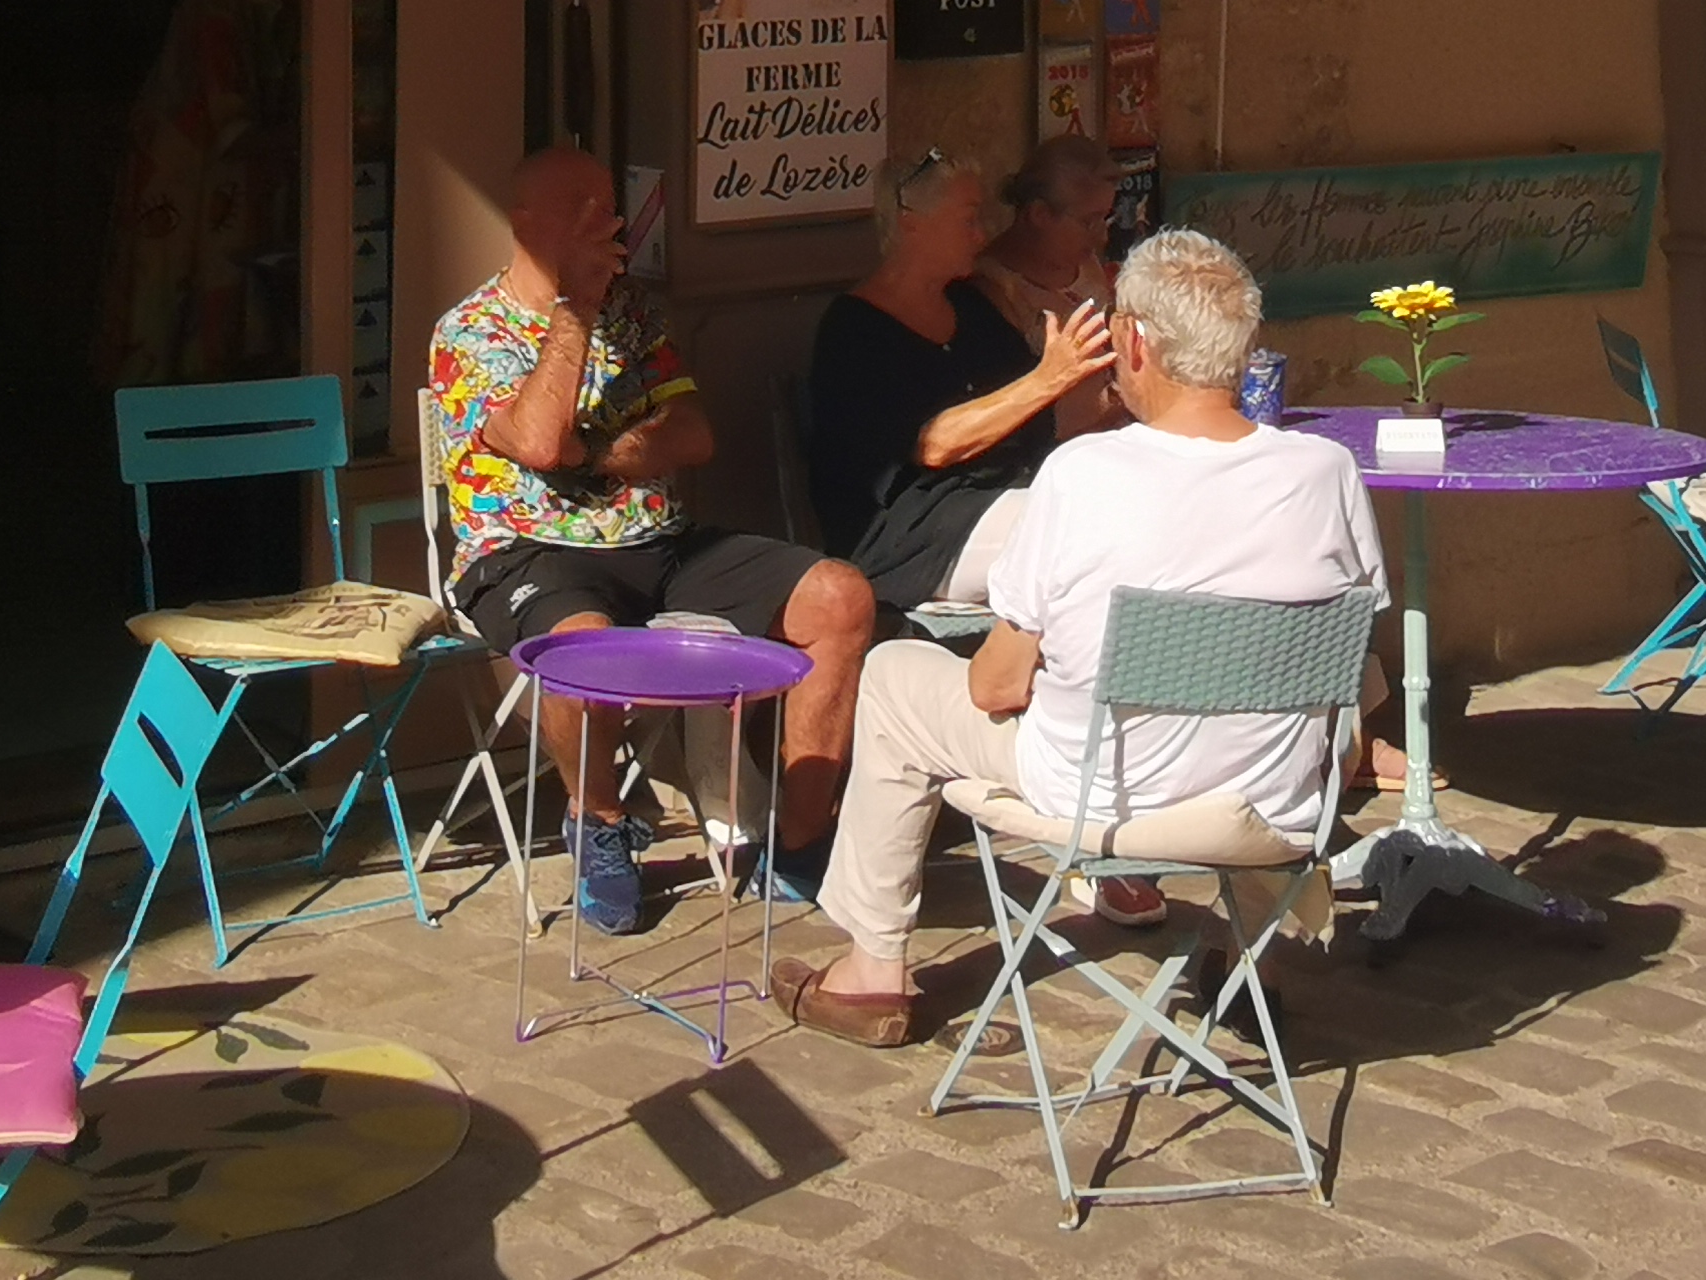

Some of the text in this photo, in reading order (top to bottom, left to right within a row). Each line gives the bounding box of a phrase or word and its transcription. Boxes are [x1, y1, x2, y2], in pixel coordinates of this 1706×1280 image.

[698, 14, 888, 52] GLACES DE LA
[745, 61, 842, 93] FERME
[698, 95, 887, 150] Lait Délices
[713, 152, 872, 201] de Lozère
